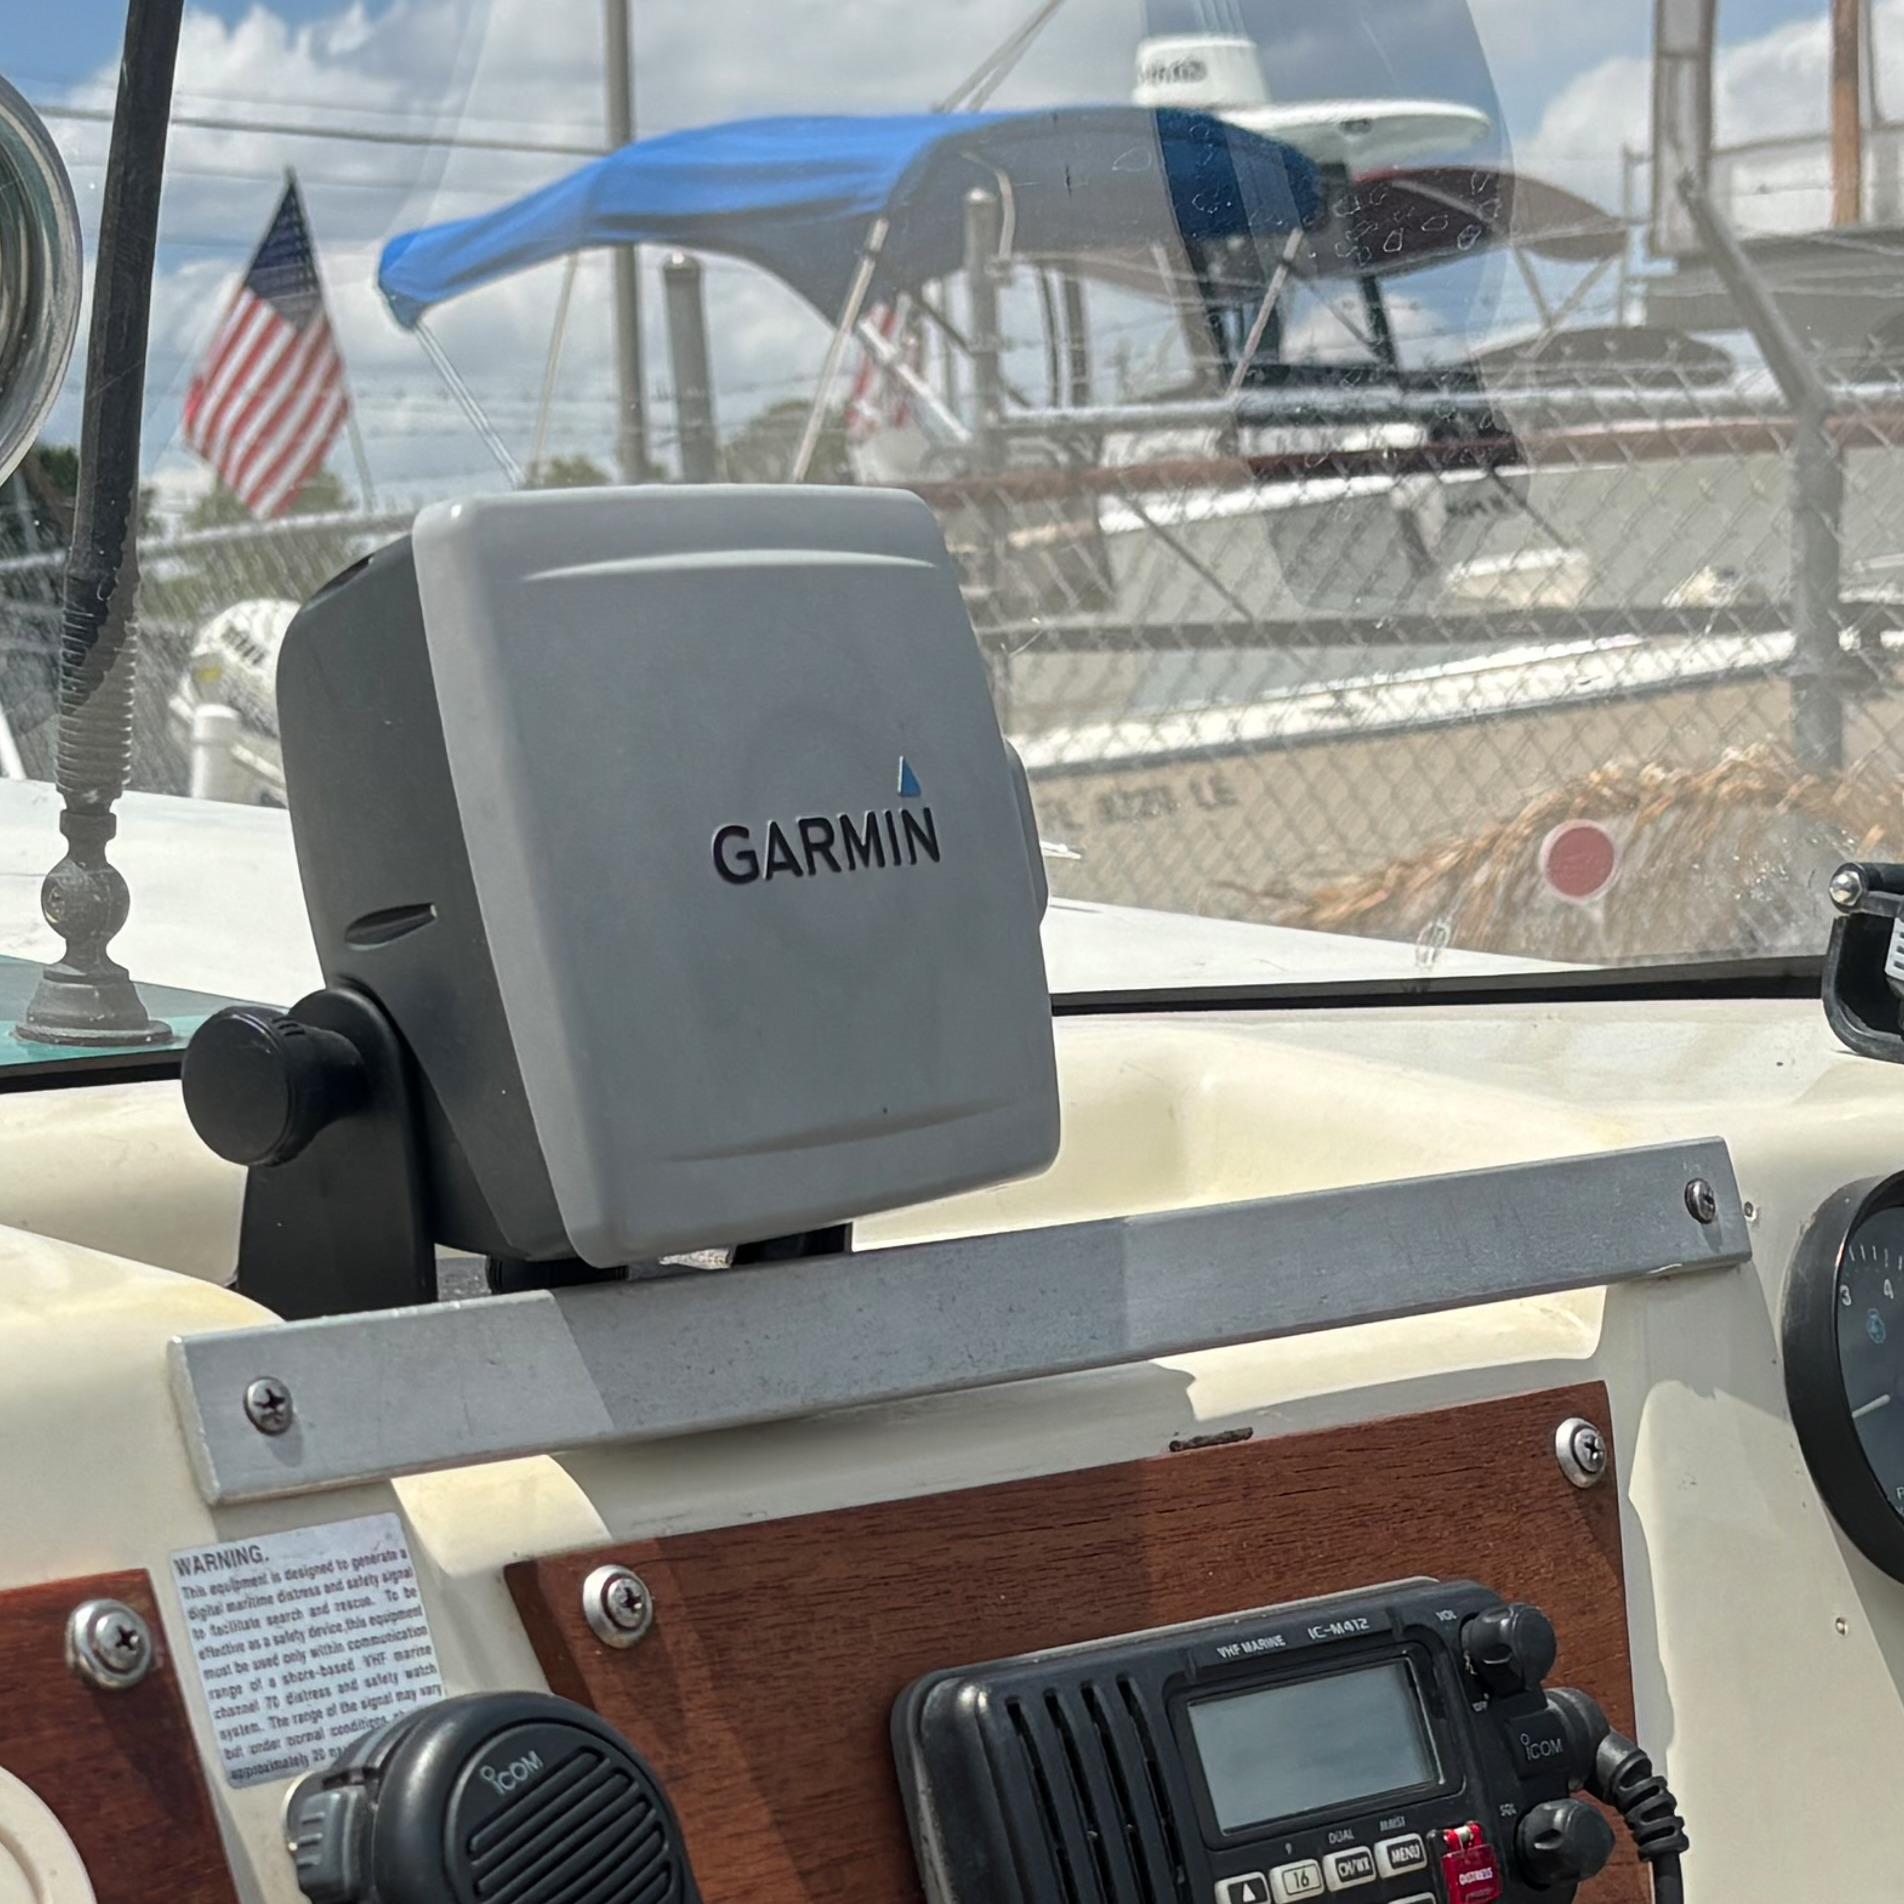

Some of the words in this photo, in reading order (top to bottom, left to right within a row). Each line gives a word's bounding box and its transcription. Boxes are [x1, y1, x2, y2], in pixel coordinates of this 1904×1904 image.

[711, 806, 941, 885] GARMIN
[1839, 1284, 1852, 1306] 3
[1882, 1278, 1895, 1300] 4
[173, 1544, 270, 1577] WARNING.
[181, 1583, 208, 1600] This
[284, 1559, 335, 1580] designed
[335, 1559, 349, 1571] to
[351, 1549, 398, 1572] generate
[399, 1549, 408, 1560] a
[226, 1593, 274, 1613] maritime
[277, 1585, 322, 1604] distress
[323, 1578, 345, 1594] and
[346, 1573, 380, 1591] safety
[382, 1566, 414, 1585] signal
[192, 1627, 207, 1641] to
[265, 1607, 304, 1626] search
[309, 1601, 330, 1618] and
[334, 1595, 375, 1612] rescue.
[384, 1588, 400, 1602] To
[403, 1586, 417, 1599] be
[247, 1639, 261, 1651] as
[263, 1636, 271, 1648] a
[272, 1627, 306, 1647] safety
[368, 1605, 423, 1627] equipment
[1307, 1617, 1371, 1640] IC-M412
[203, 1663, 233, 1681] must
[233, 1660, 250, 1674] be
[252, 1653, 280, 1671] used
[282, 1649, 307, 1665] only
[310, 1641, 345, 1659] within
[346, 1625, 428, 1651] communication
[1240, 1634, 1287, 1654] MARINE
[207, 1683, 243, 1701] range
[249, 1677, 264, 1692] of
[268, 1676, 277, 1689] a
[281, 1658, 356, 1686] shore-based
[362, 1651, 386, 1668] VHF
[393, 1645, 432, 1662] marine
[213, 1699, 260, 1720] channel
[285, 1686, 332, 1706] distress
[337, 1678, 359, 1694] and
[364, 1672, 400, 1688] safety
[404, 1662, 438, 1679] watch
[266, 1715, 290, 1730] The
[291, 1708, 324, 1725] range
[325, 1702, 339, 1718] of
[339, 1700, 358, 1715] the
[360, 1691, 394, 1711] signal
[395, 1689, 418, 1703] may
[418, 1683, 443, 1698] vary
[225, 1745, 244, 1761] but
[249, 1737, 282, 1756] under
[286, 1727, 326, 1747] normal
[1328, 1828, 1355, 1845] DUAL
[1391, 1843, 1422, 1864] MENU
[1293, 1867, 1310, 1890] 16
